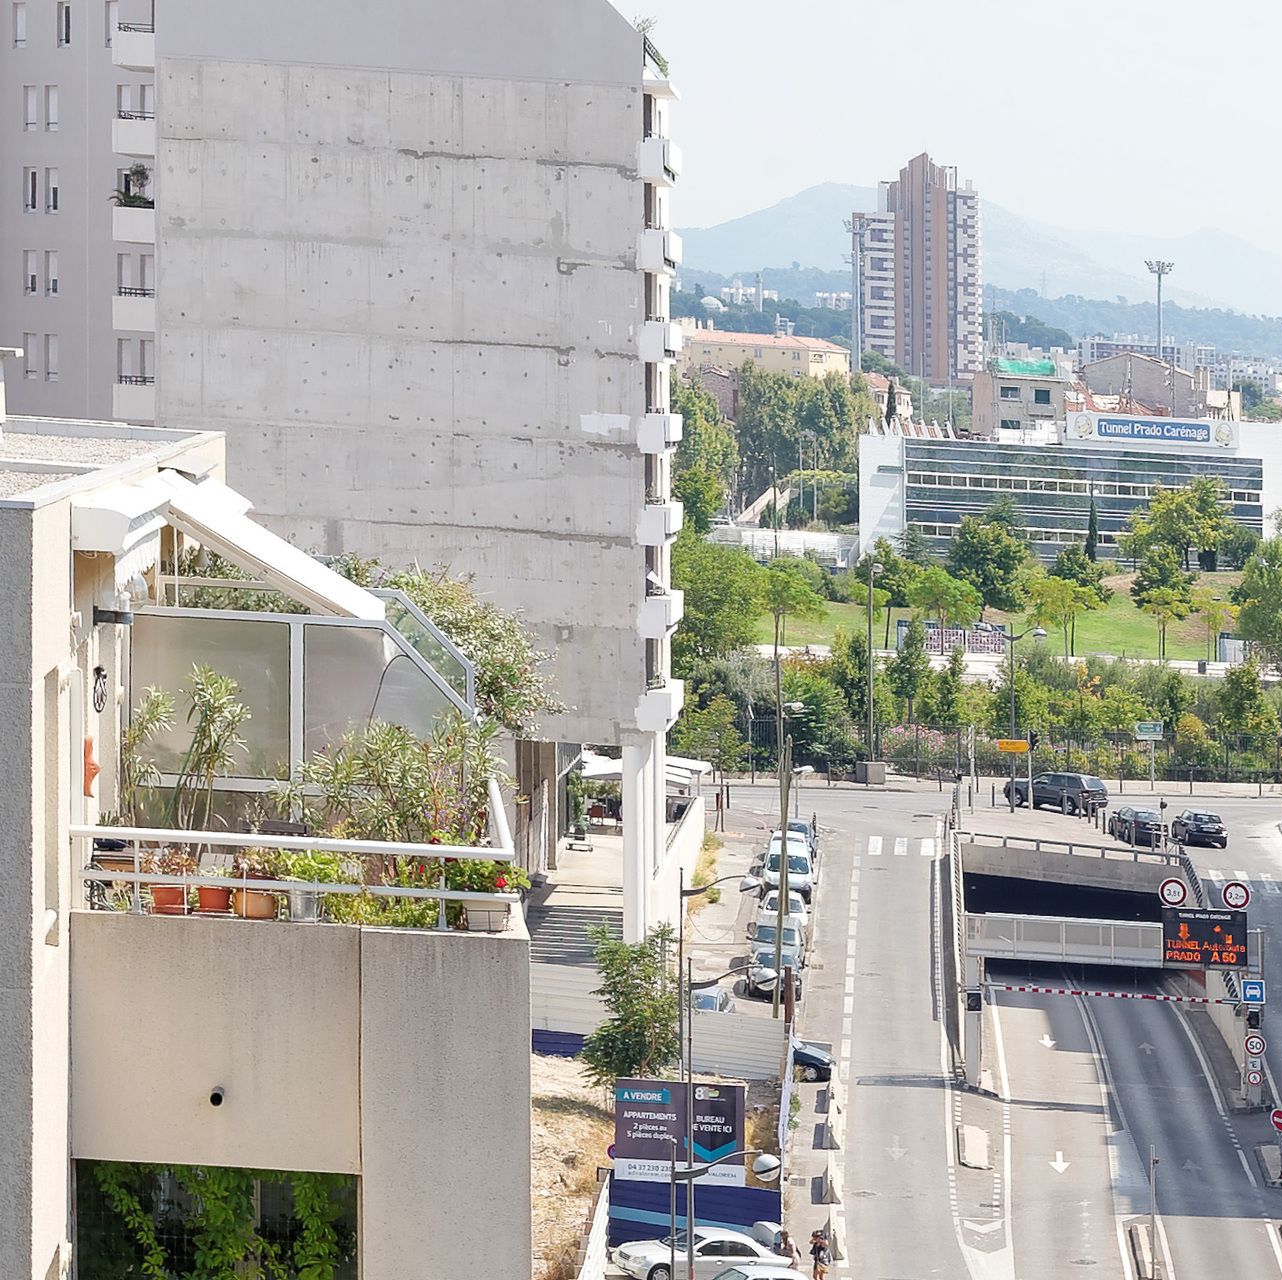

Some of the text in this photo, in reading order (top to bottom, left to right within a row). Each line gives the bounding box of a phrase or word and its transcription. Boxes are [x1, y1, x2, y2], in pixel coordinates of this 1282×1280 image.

[1100, 422, 1208, 439] Tunnel Prado Carénage
[1168, 940, 1200, 950] TUNNEL
[1166, 951, 1200, 962] PRADO
[1211, 952, 1220, 962] A
[1250, 1041, 1261, 1050] 50
[624, 1092, 662, 1100] A VENDRE
[624, 1111, 676, 1121] APPARTEMENTS
[700, 1124, 722, 1132] VENTE
